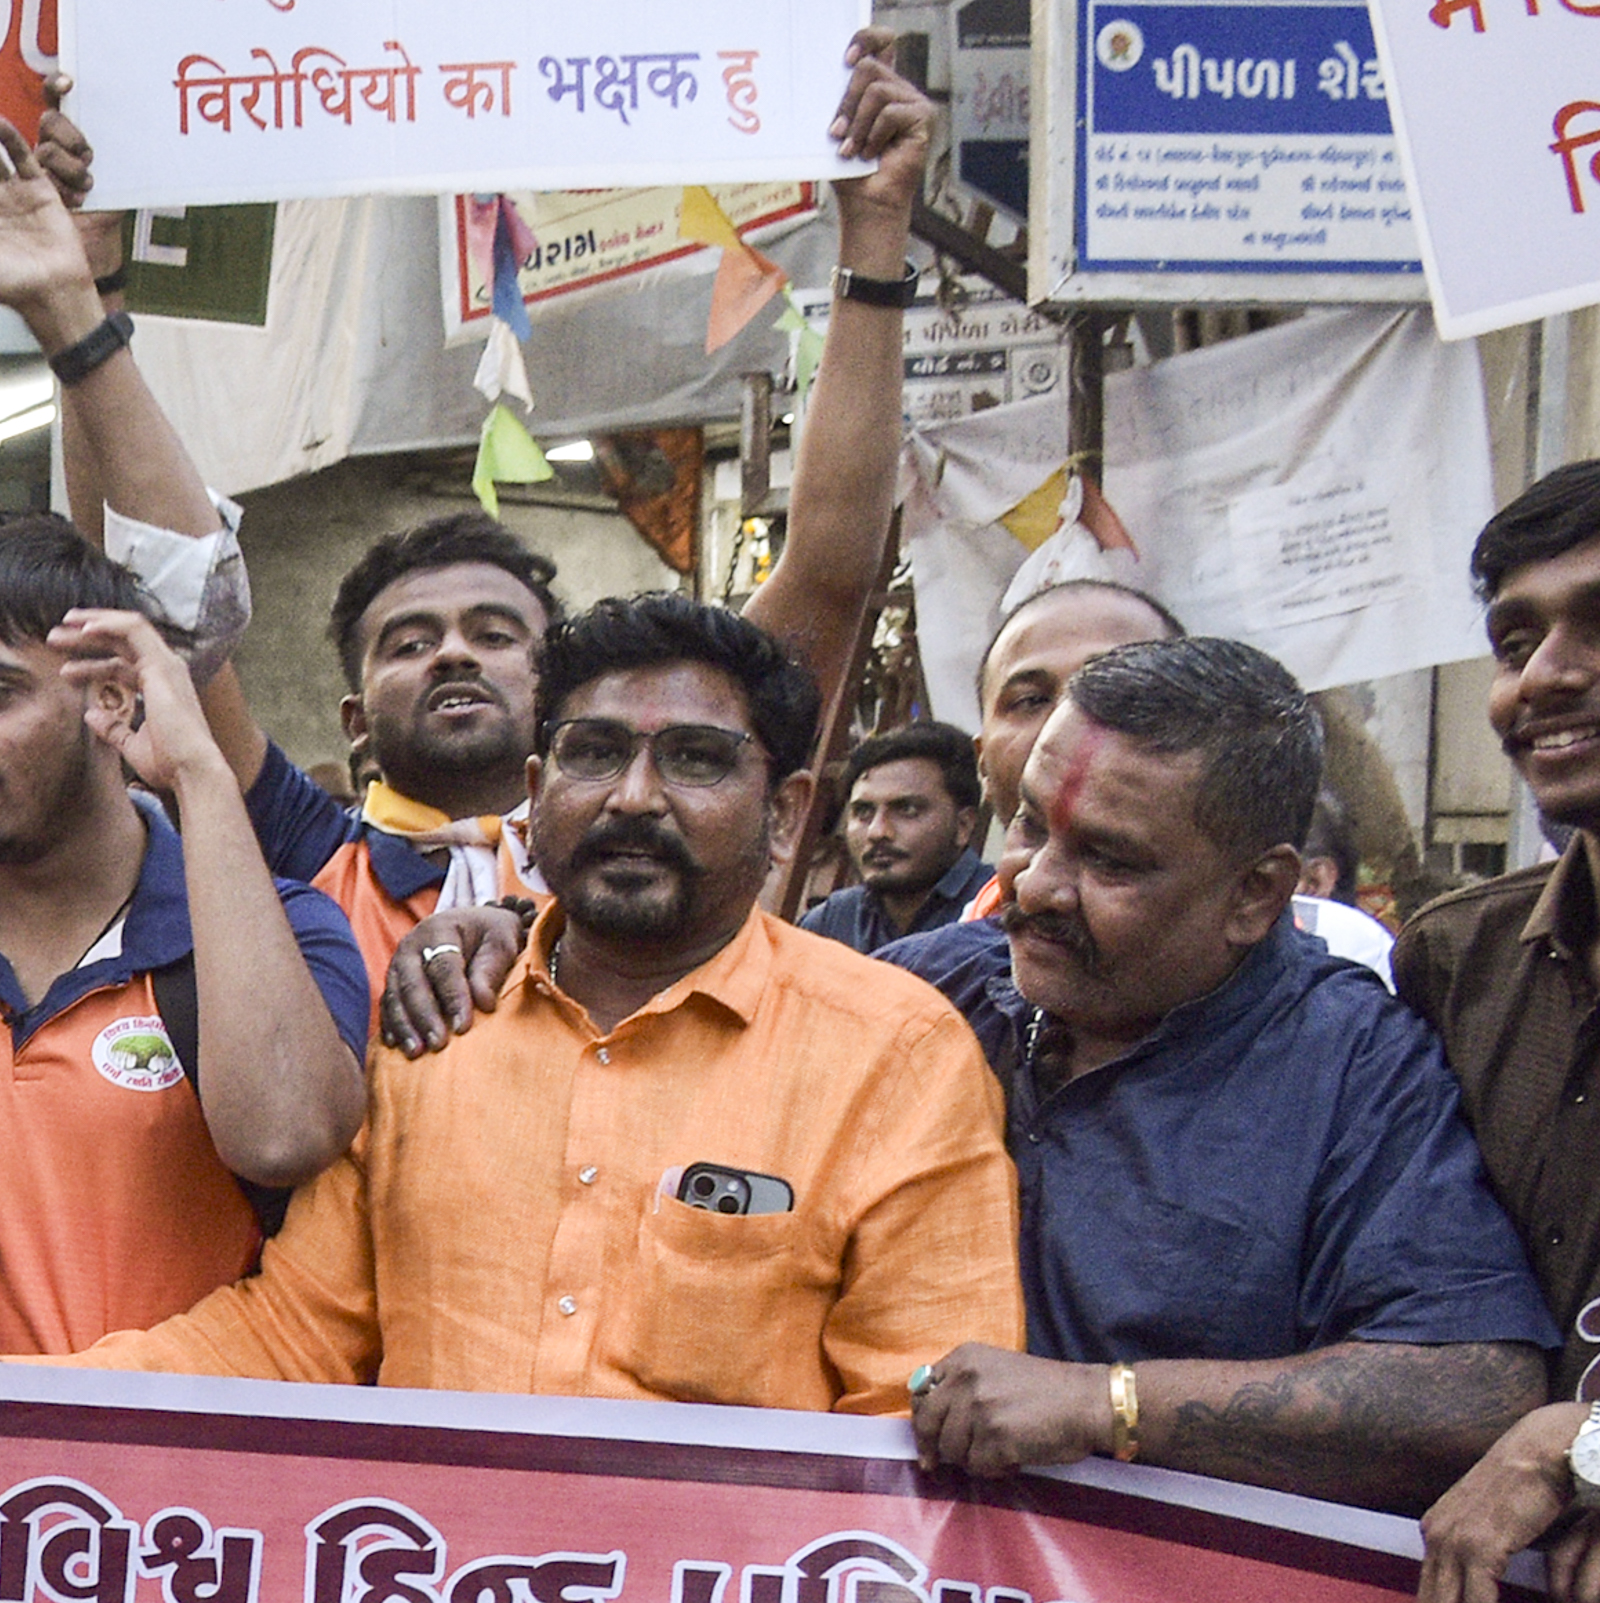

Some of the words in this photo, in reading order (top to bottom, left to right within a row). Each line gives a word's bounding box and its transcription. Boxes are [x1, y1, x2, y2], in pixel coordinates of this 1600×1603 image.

[439, 60, 517, 119] का
[538, 50, 701, 126] भक्षक
[1152, 42, 1297, 101] પીપળા
